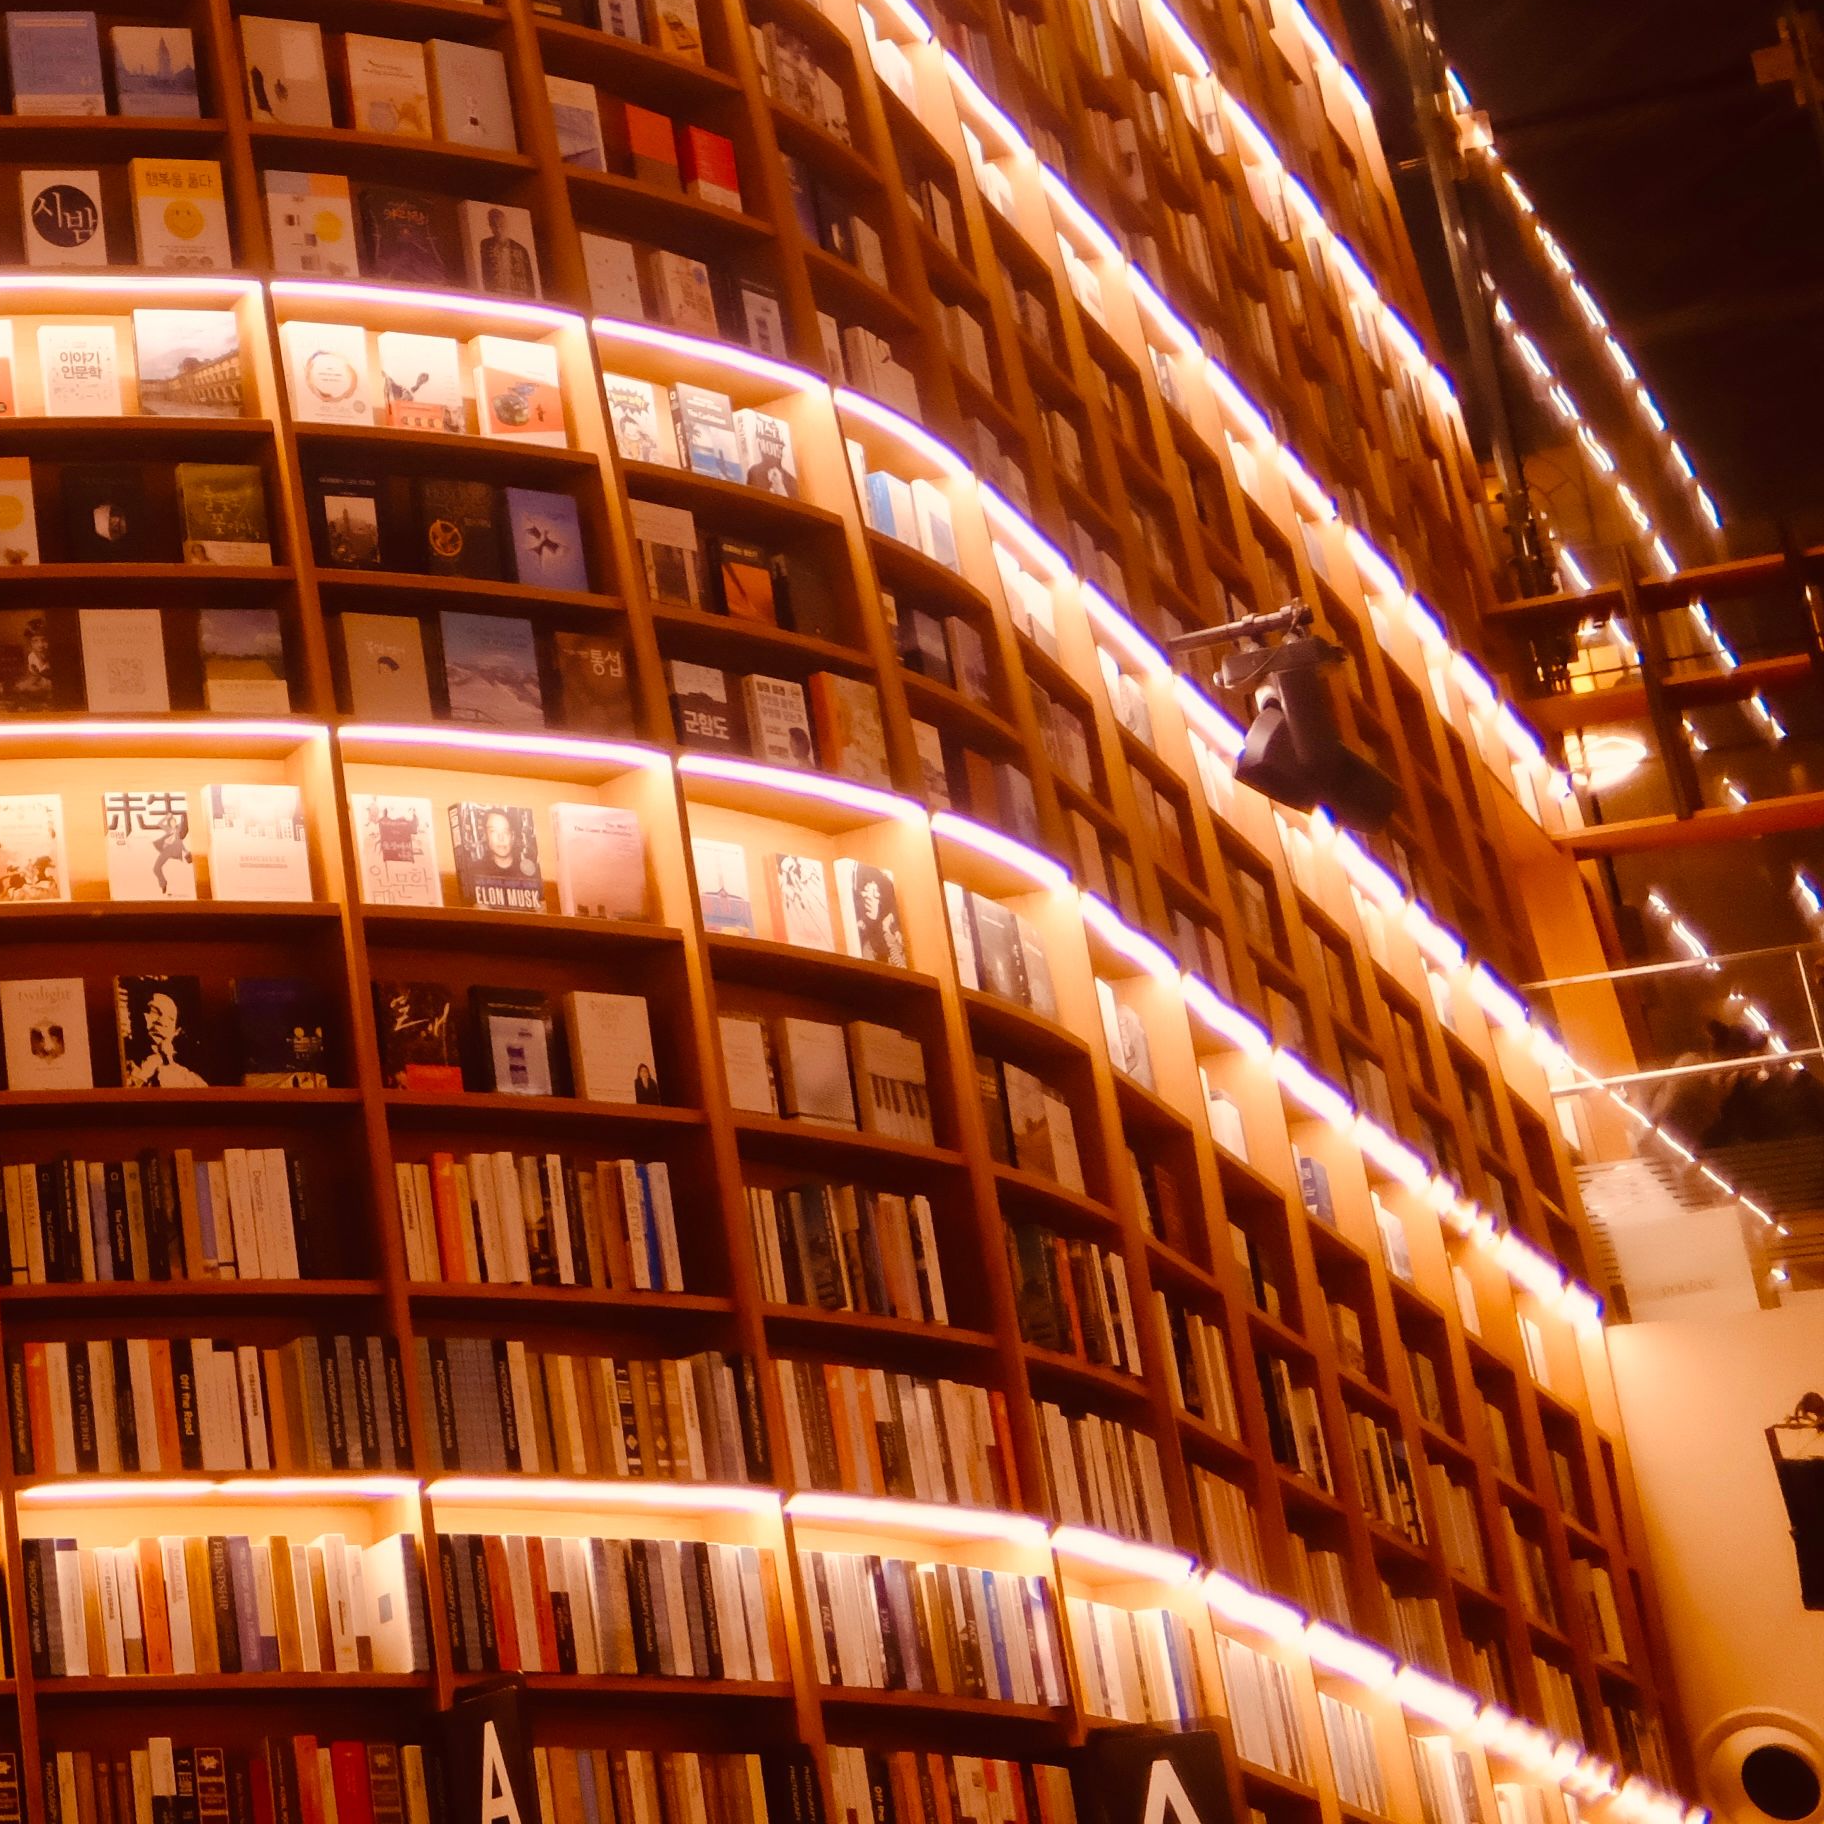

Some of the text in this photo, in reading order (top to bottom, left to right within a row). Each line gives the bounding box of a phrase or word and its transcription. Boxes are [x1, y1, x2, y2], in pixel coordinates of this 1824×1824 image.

[59, 351, 100, 366] 이야기
[60, 366, 102, 380] 인문학
[591, 648, 626, 679] 통섭
[683, 710, 731, 741] 군함도
[475, 886, 542, 910] ELON MUSK
[179, 1373, 190, 1389] Off
[183, 1411, 195, 1436] Road
